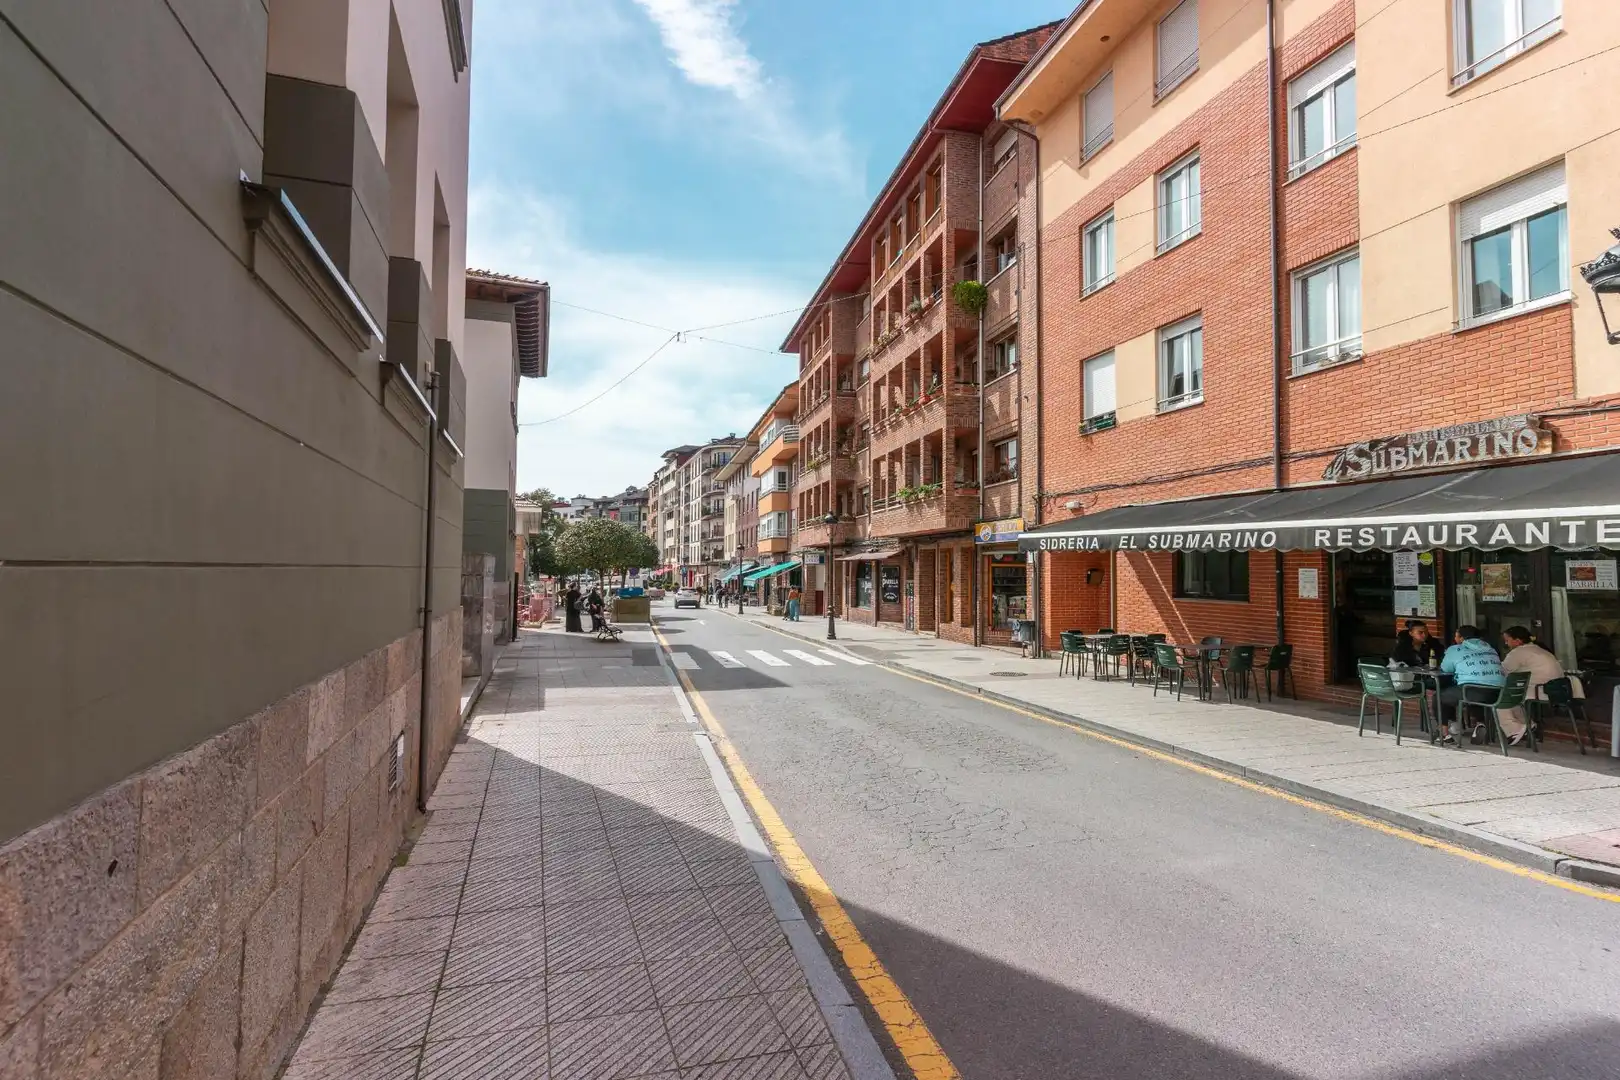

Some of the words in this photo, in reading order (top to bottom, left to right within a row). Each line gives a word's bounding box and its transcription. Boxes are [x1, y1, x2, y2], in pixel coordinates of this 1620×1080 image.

[1345, 427, 1538, 477] SUBMARINO
[1039, 536, 1099, 550] SIDRERIA
[1118, 535, 1137, 549] EL
[1148, 531, 1277, 549] SUBMARINO
[1314, 519, 1620, 547] RESTAURANTE
[1570, 580, 1614, 588] PARRILLA
